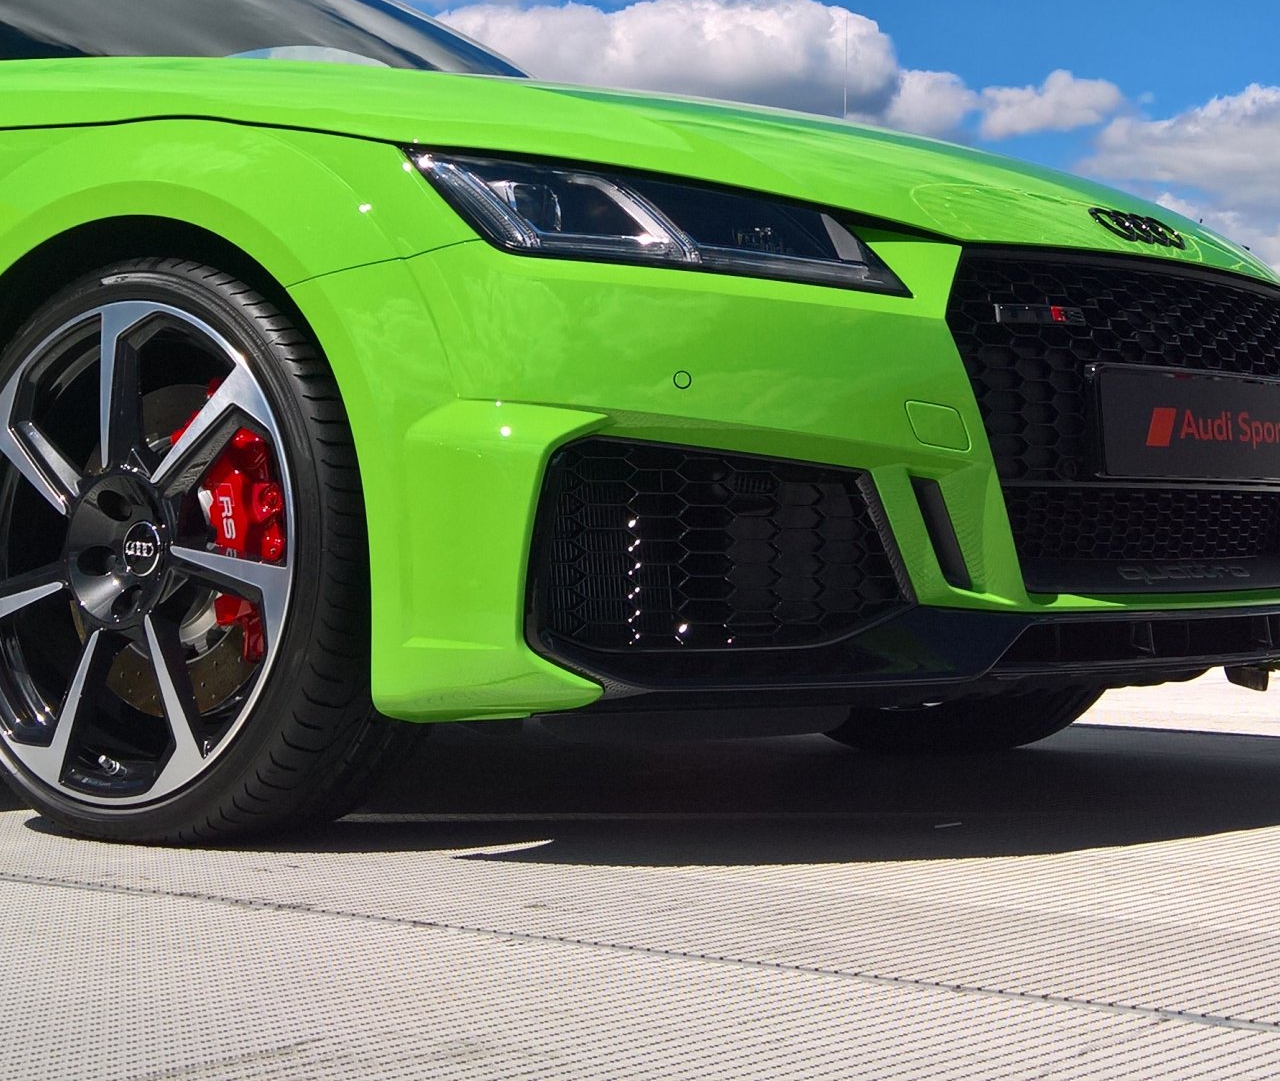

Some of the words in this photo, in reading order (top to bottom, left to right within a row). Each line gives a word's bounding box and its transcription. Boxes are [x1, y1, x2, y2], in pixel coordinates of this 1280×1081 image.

[1179, 410, 1233, 441] Audi
[218, 496, 236, 540] RS
[1117, 561, 1251, 585] quattro
